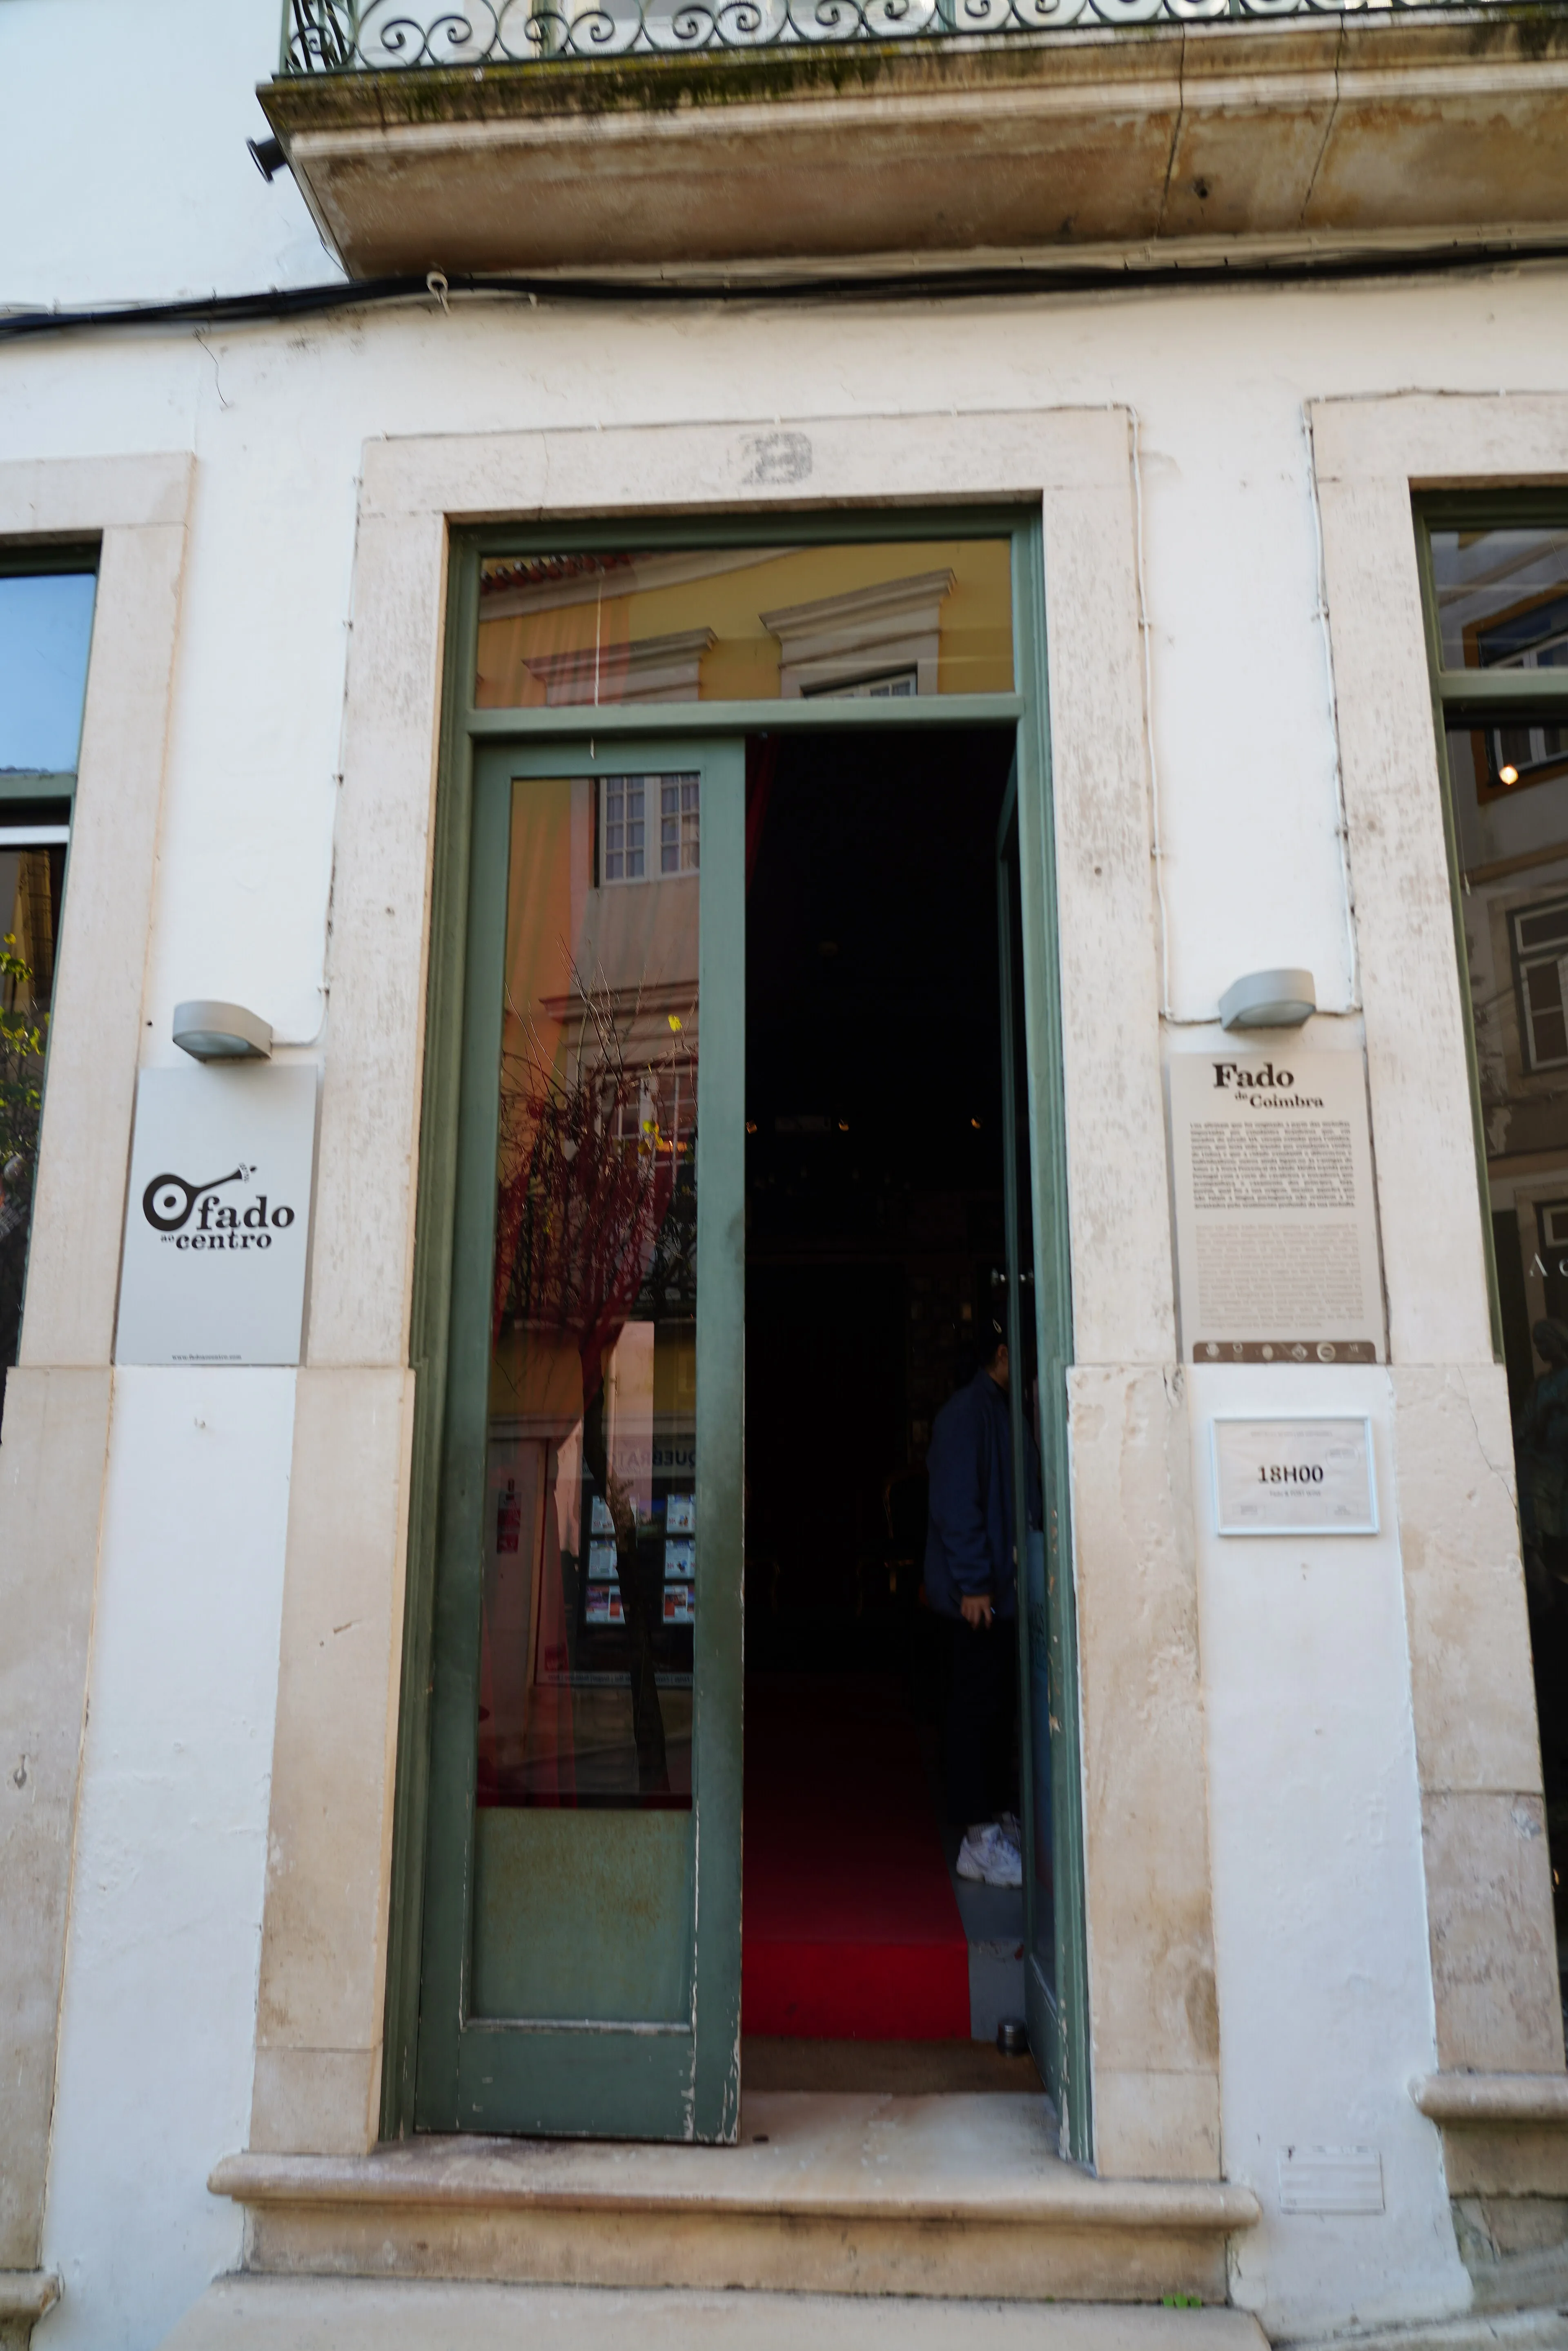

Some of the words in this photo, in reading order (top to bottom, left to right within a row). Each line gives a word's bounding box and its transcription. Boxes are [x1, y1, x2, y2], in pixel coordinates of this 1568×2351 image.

[1212, 1061, 1294, 1089] Fado
[1234, 1090, 1248, 1101] de
[1250, 1093, 1324, 1110] Coimbra
[160, 1234, 174, 1243] ao
[176, 1227, 272, 1250] centro
[1258, 1463, 1323, 1484] 18H00
